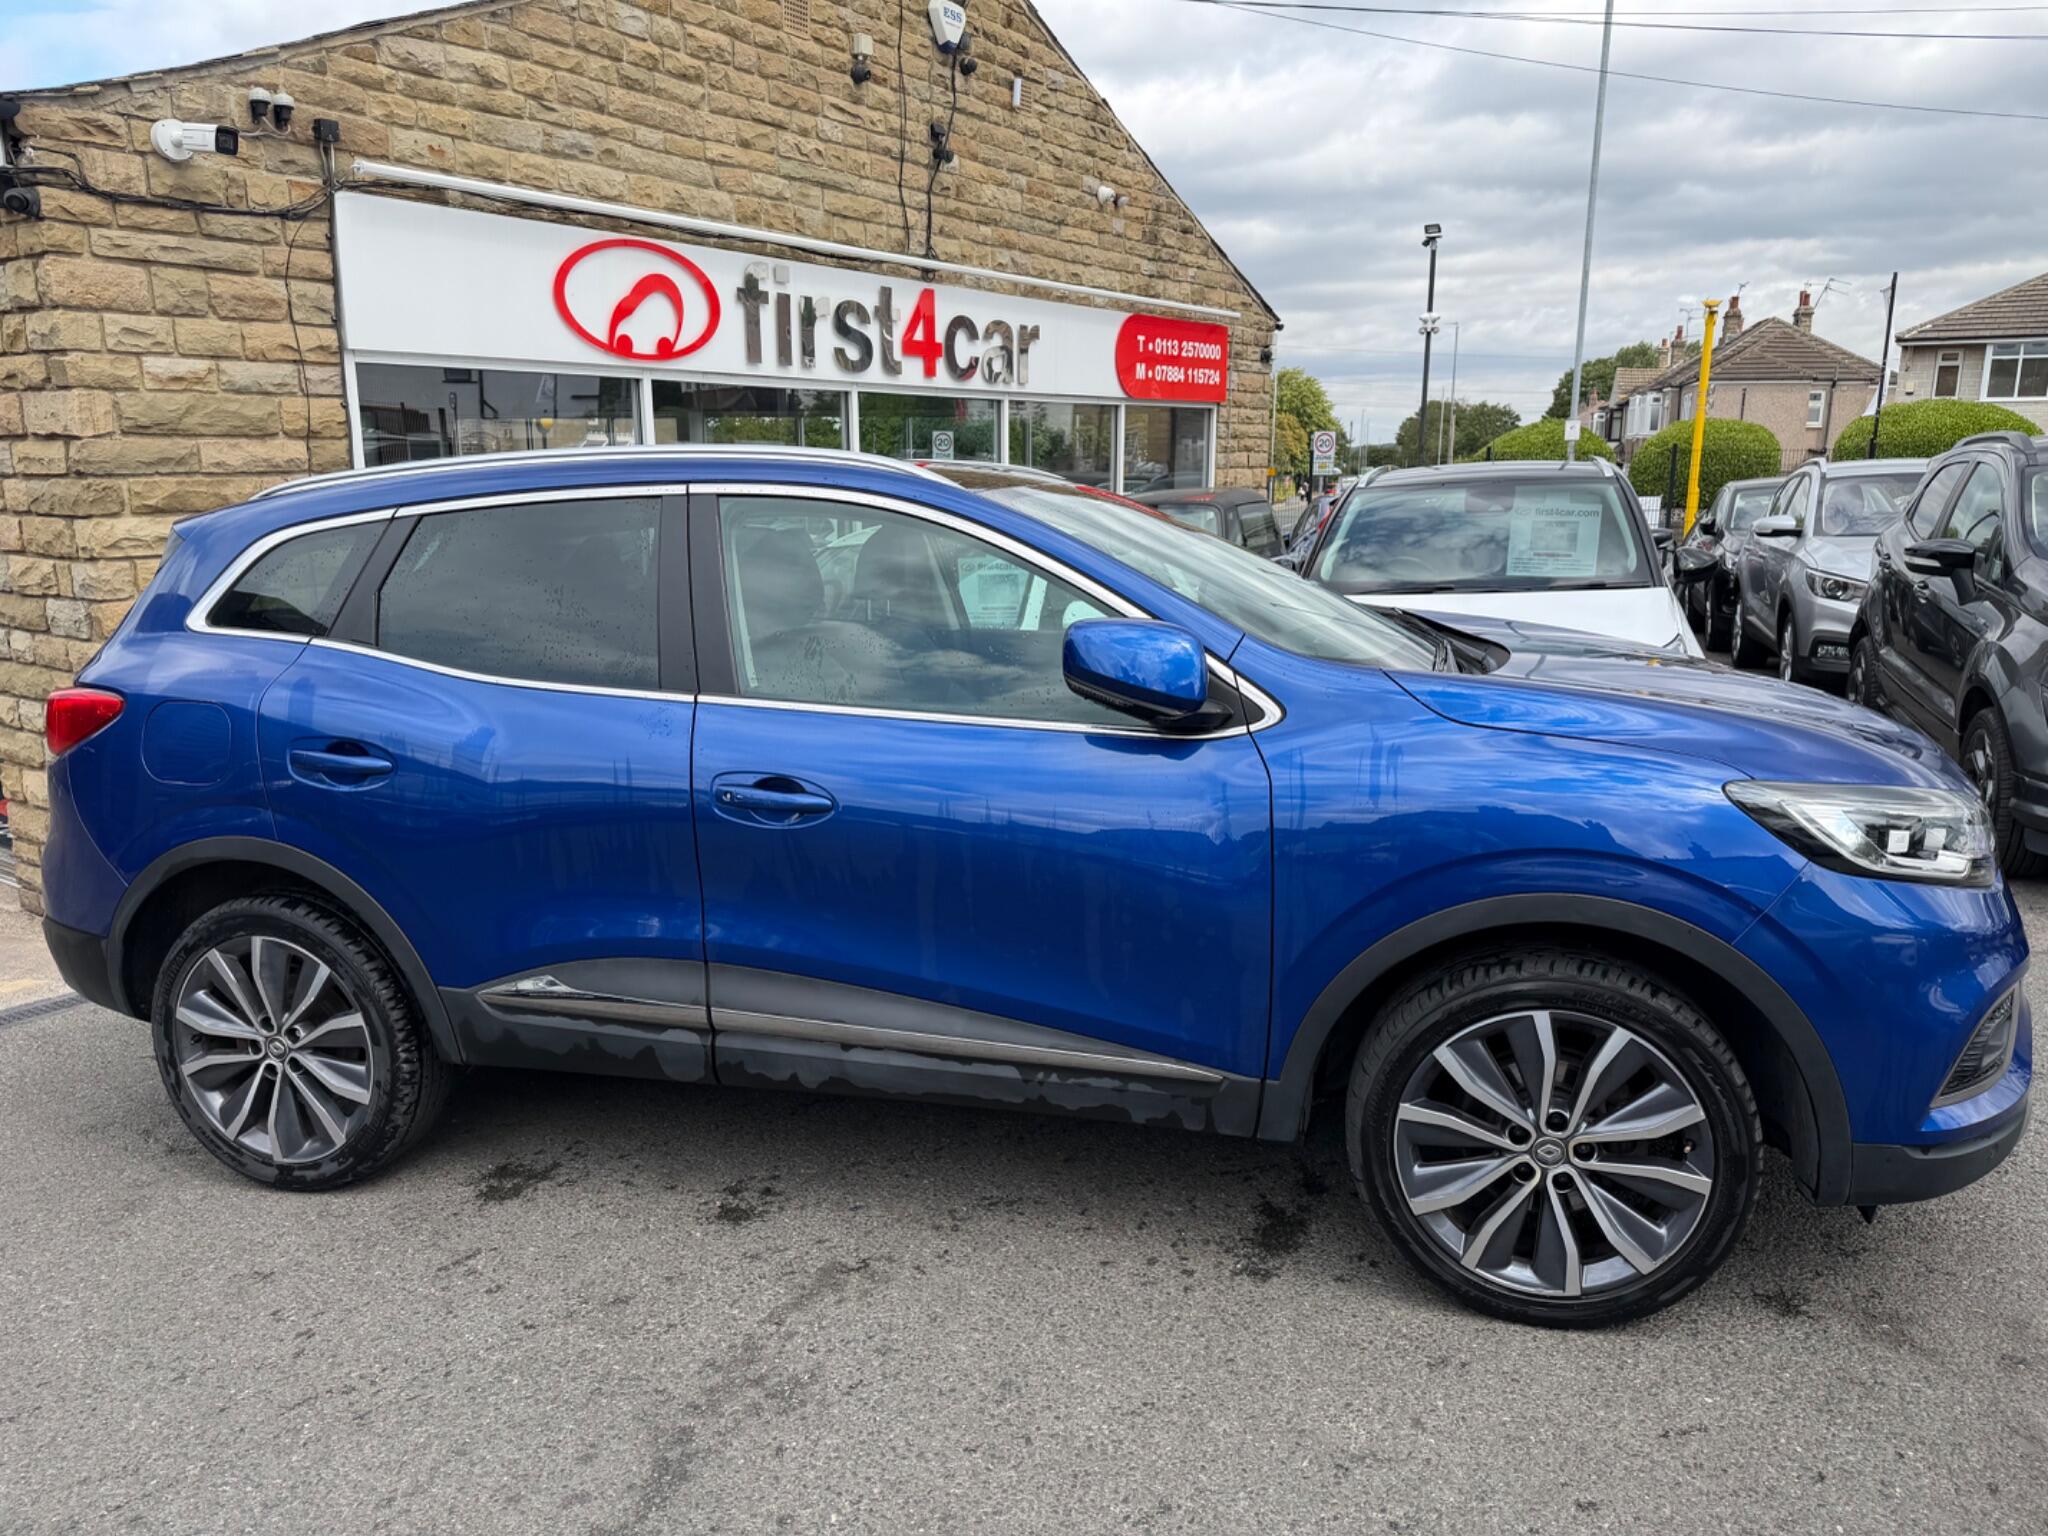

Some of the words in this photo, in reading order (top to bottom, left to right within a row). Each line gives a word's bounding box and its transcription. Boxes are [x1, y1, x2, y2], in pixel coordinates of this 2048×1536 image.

[943, 6, 962, 23] ESS
[736, 261, 1040, 385] first4car
[1137, 335, 1146, 353] T
[1155, 338, 1179, 357] 0113
[1181, 341, 1221, 360] 2570000
[1135, 362, 1146, 380] M
[1155, 365, 1185, 383] 07884
[1187, 368, 1220, 385] 115724
[937, 438, 950, 447] 20
[1318, 438, 1331, 448] 20
